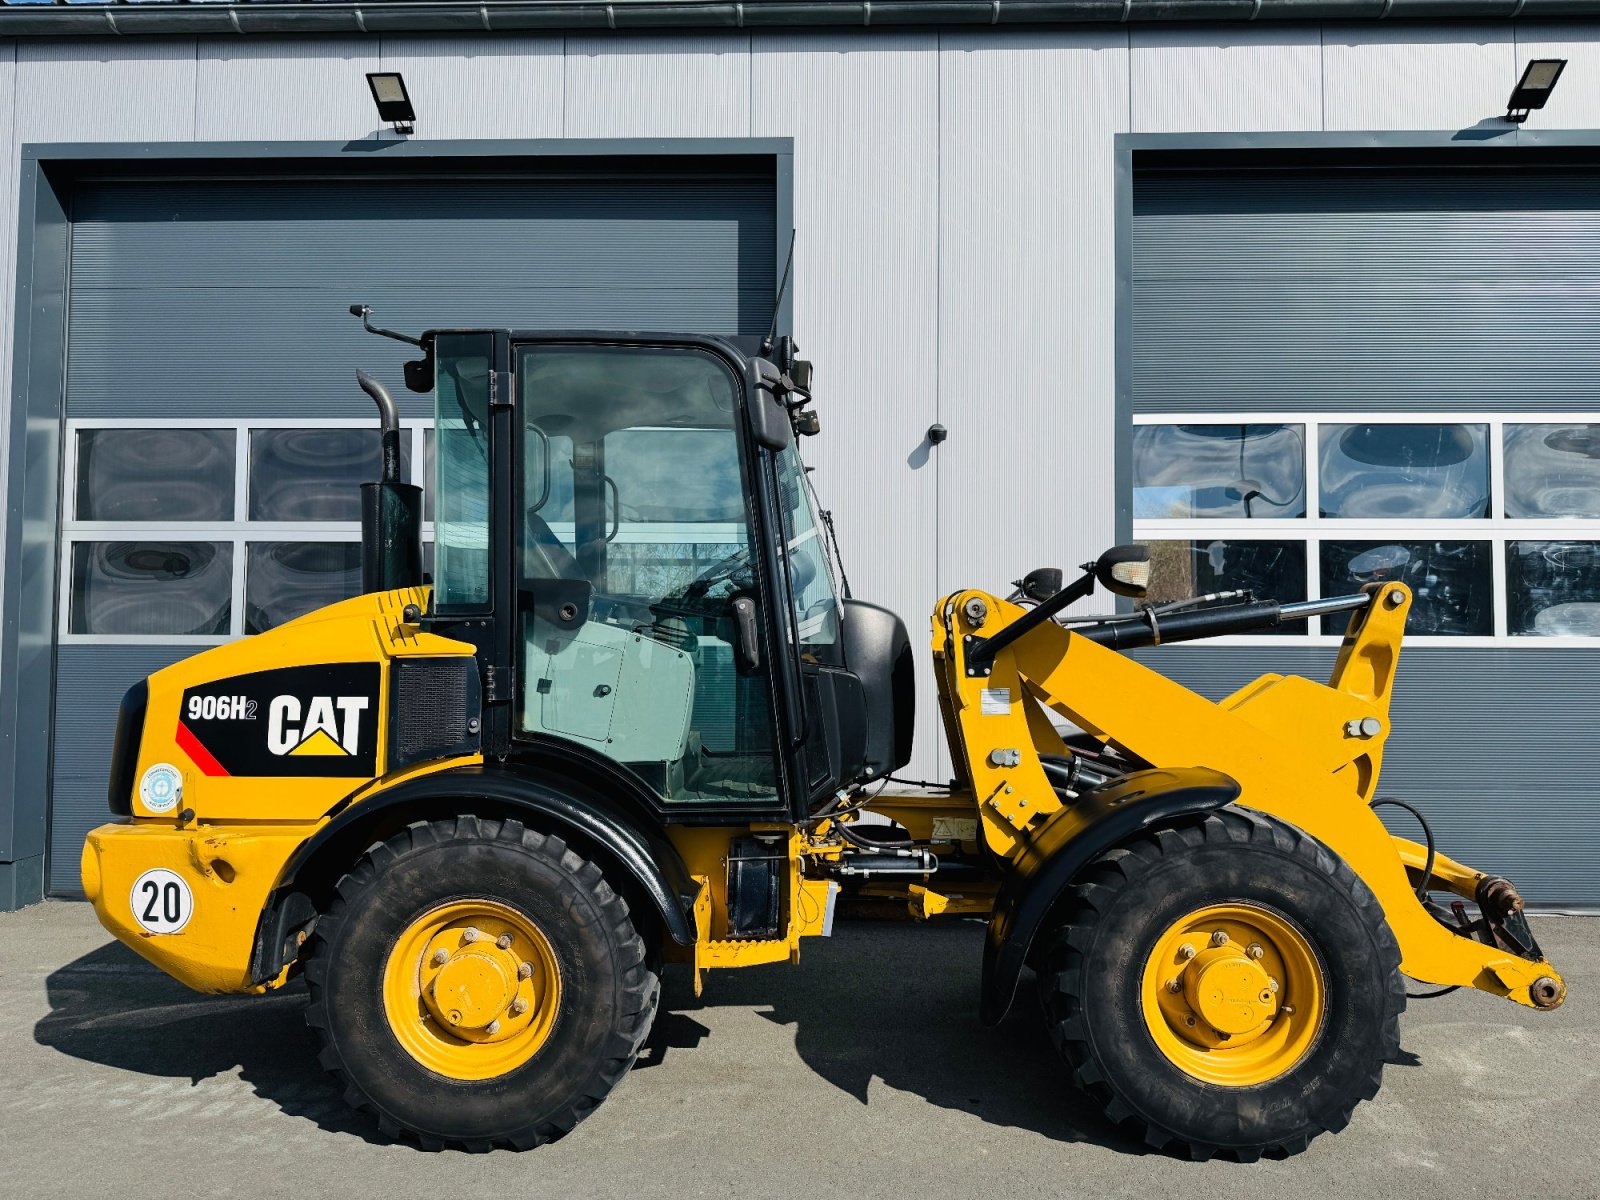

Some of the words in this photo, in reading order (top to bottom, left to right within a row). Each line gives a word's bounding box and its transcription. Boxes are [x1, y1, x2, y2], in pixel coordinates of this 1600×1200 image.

[188, 695, 258, 720] 906H2
[267, 694, 369, 756] CAT
[142, 880, 181, 924] 20
